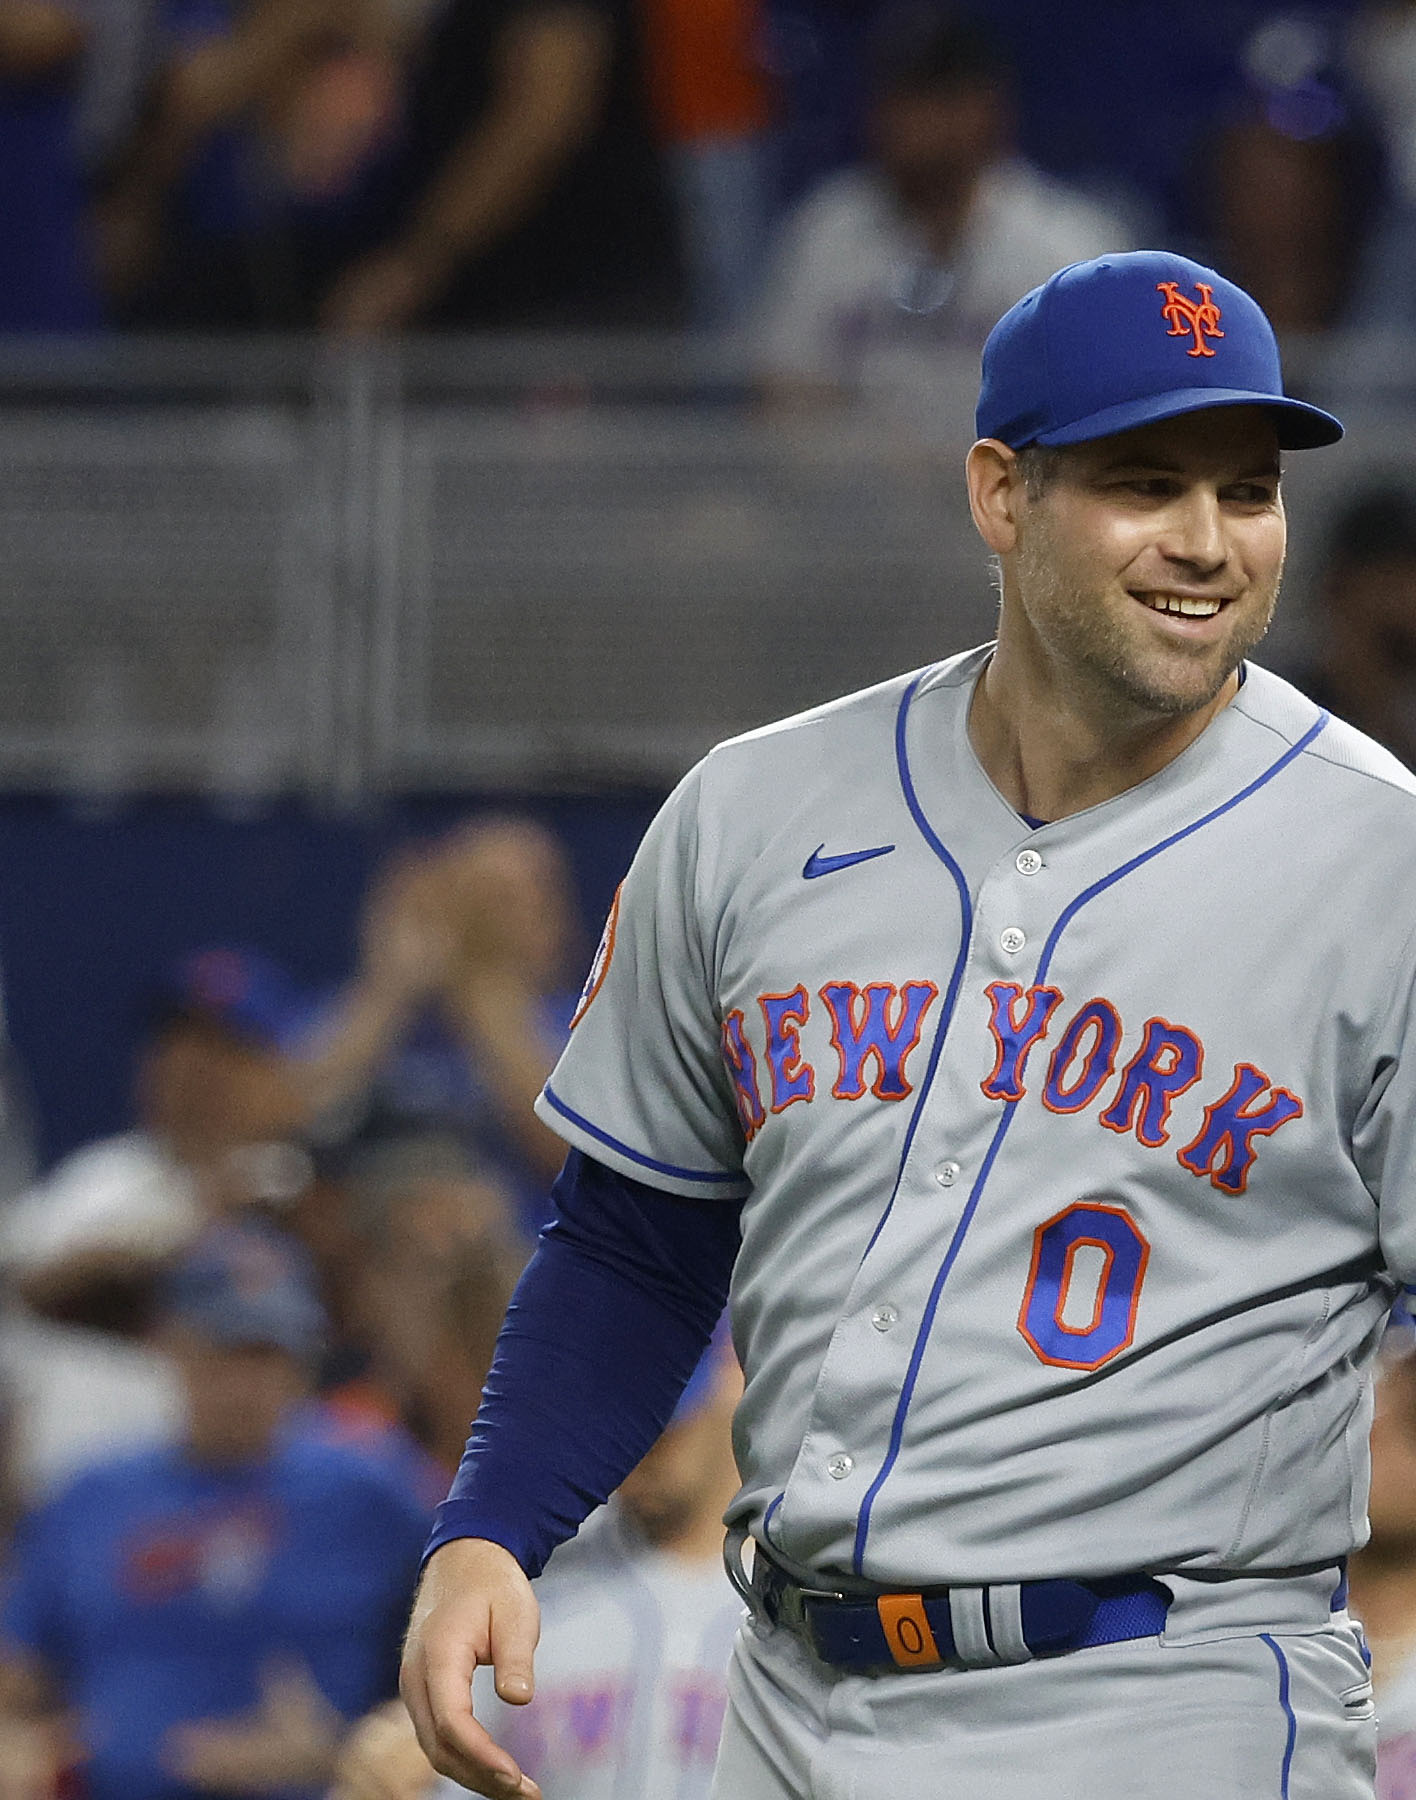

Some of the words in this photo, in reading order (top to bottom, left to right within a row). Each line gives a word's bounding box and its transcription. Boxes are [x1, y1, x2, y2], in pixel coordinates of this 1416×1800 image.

[1156, 281, 1226, 357] NY
[721, 980, 938, 1141] NEW
[980, 981, 1303, 1195] YORK
[1017, 1201, 1150, 1372] 0
